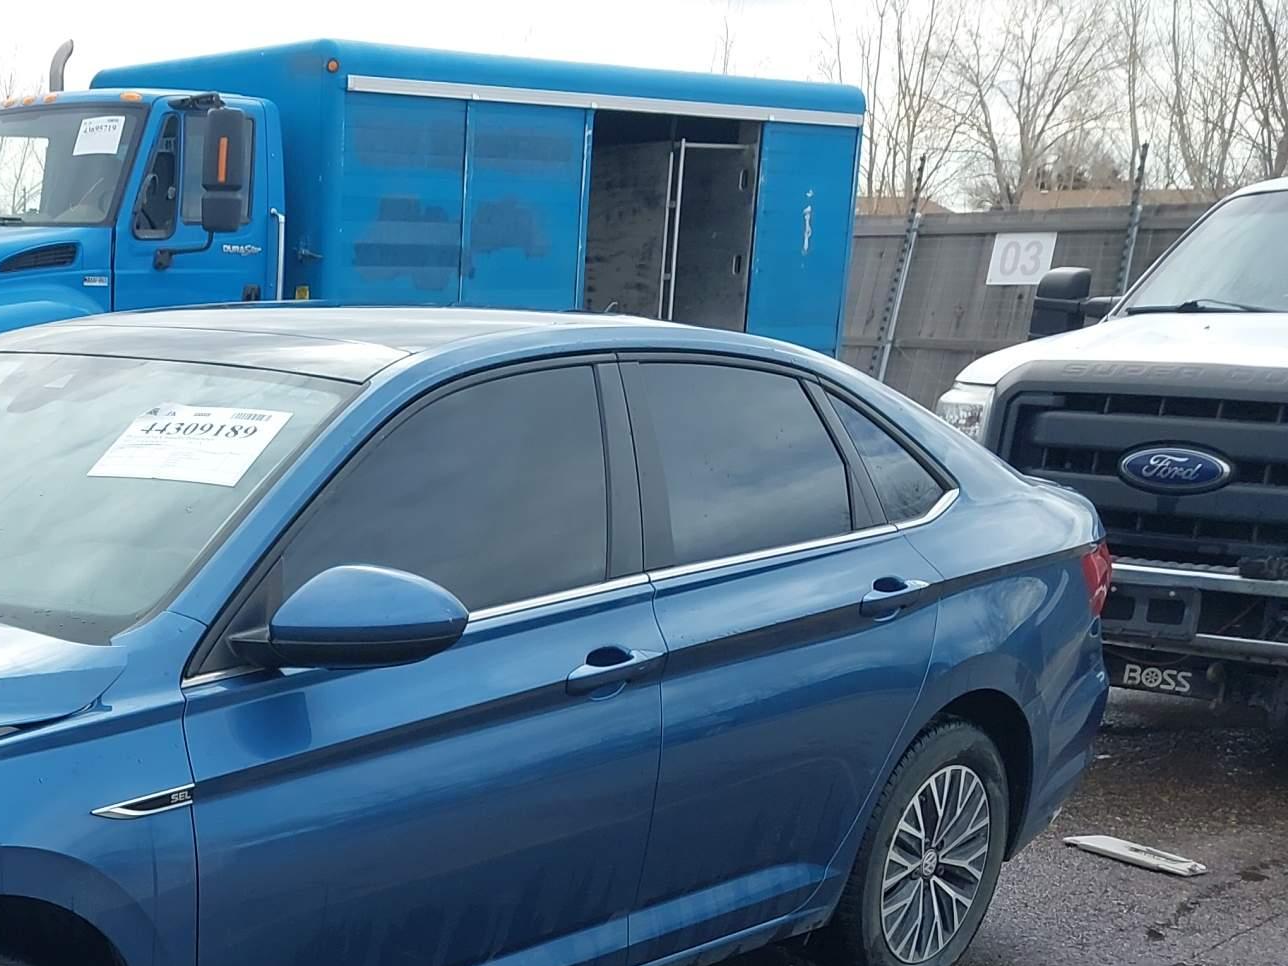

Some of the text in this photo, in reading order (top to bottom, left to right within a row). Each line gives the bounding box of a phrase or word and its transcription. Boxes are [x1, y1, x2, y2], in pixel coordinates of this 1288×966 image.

[1000, 241, 1043, 276] 03
[1062, 363, 1206, 379] SUPER
[141, 422, 258, 439] 44309189
[1142, 454, 1202, 480] Ford
[1123, 664, 1192, 692] BOSS
[171, 791, 191, 803] SEL
